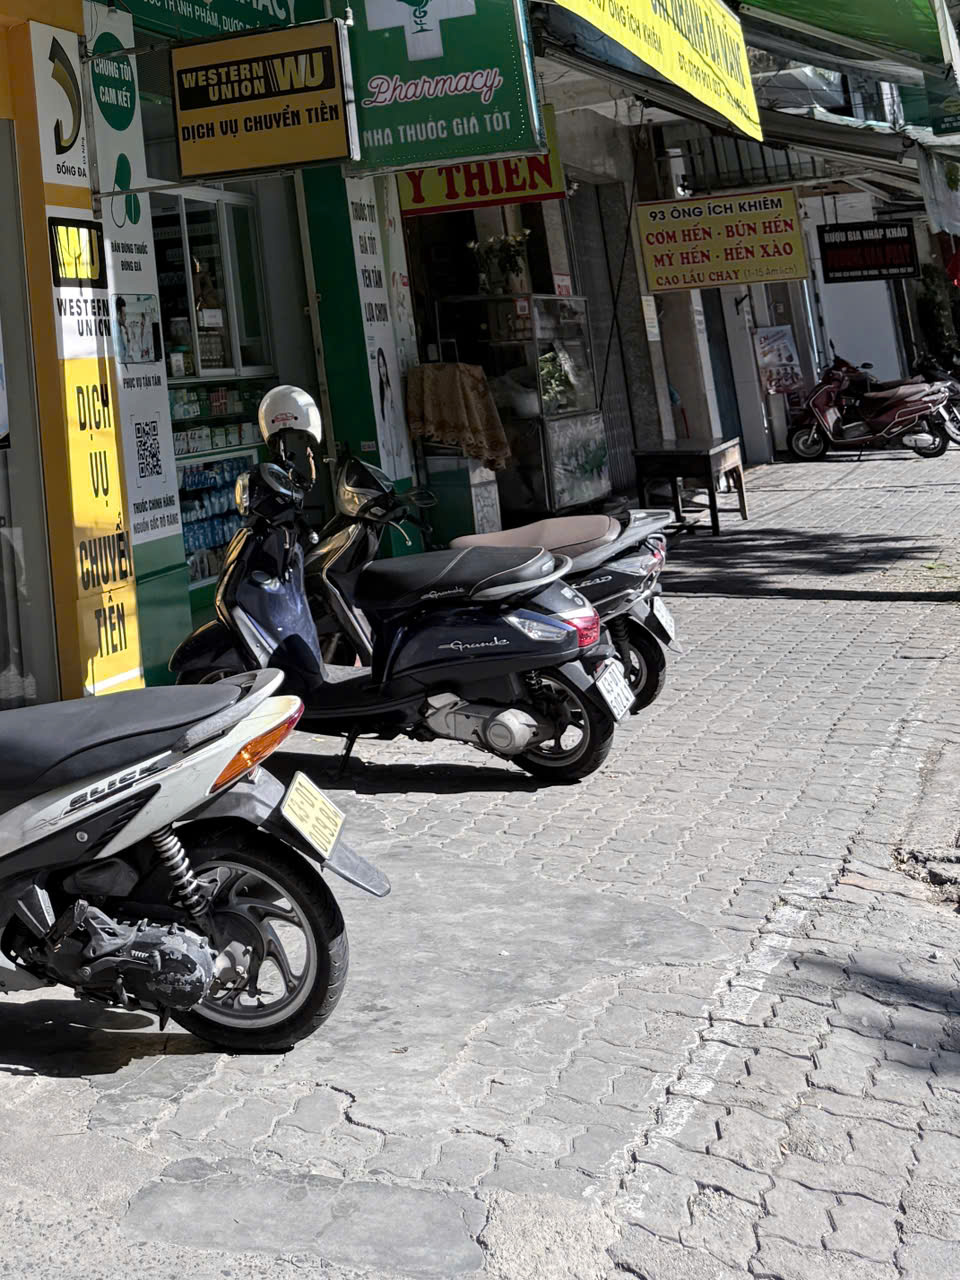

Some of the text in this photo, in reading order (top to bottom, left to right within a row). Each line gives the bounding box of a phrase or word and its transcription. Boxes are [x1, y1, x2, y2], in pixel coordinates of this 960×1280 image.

[182, 52, 325, 91] WESTERN WU
[99, 86, 116, 105] CAM
[208, 78, 265, 102] UNION
[361, 67, 503, 109] Pharmacy
[182, 100, 339, 143] DỊCH VỤ CHUYỂN TIỀN
[649, 197, 782, 221] 93 ÔNG ÍCH KHIÊM
[646, 229, 677, 246] CƠM
[682, 222, 712, 243] HẾN
[762, 214, 794, 235] HẾN
[847, 229, 862, 241] BIA
[679, 245, 711, 265] HẾN
[724, 240, 755, 261] HẾN
[760, 239, 793, 258] XÀO
[656, 275, 679, 286] CAO
[709, 269, 740, 282] CHAY
[77, 318, 111, 337] UNION
[76, 383, 111, 440] DỊCH
[89, 450, 109, 507] VỤ
[443, 637, 510, 651] Grande
[69, 759, 167, 808] CLICK
